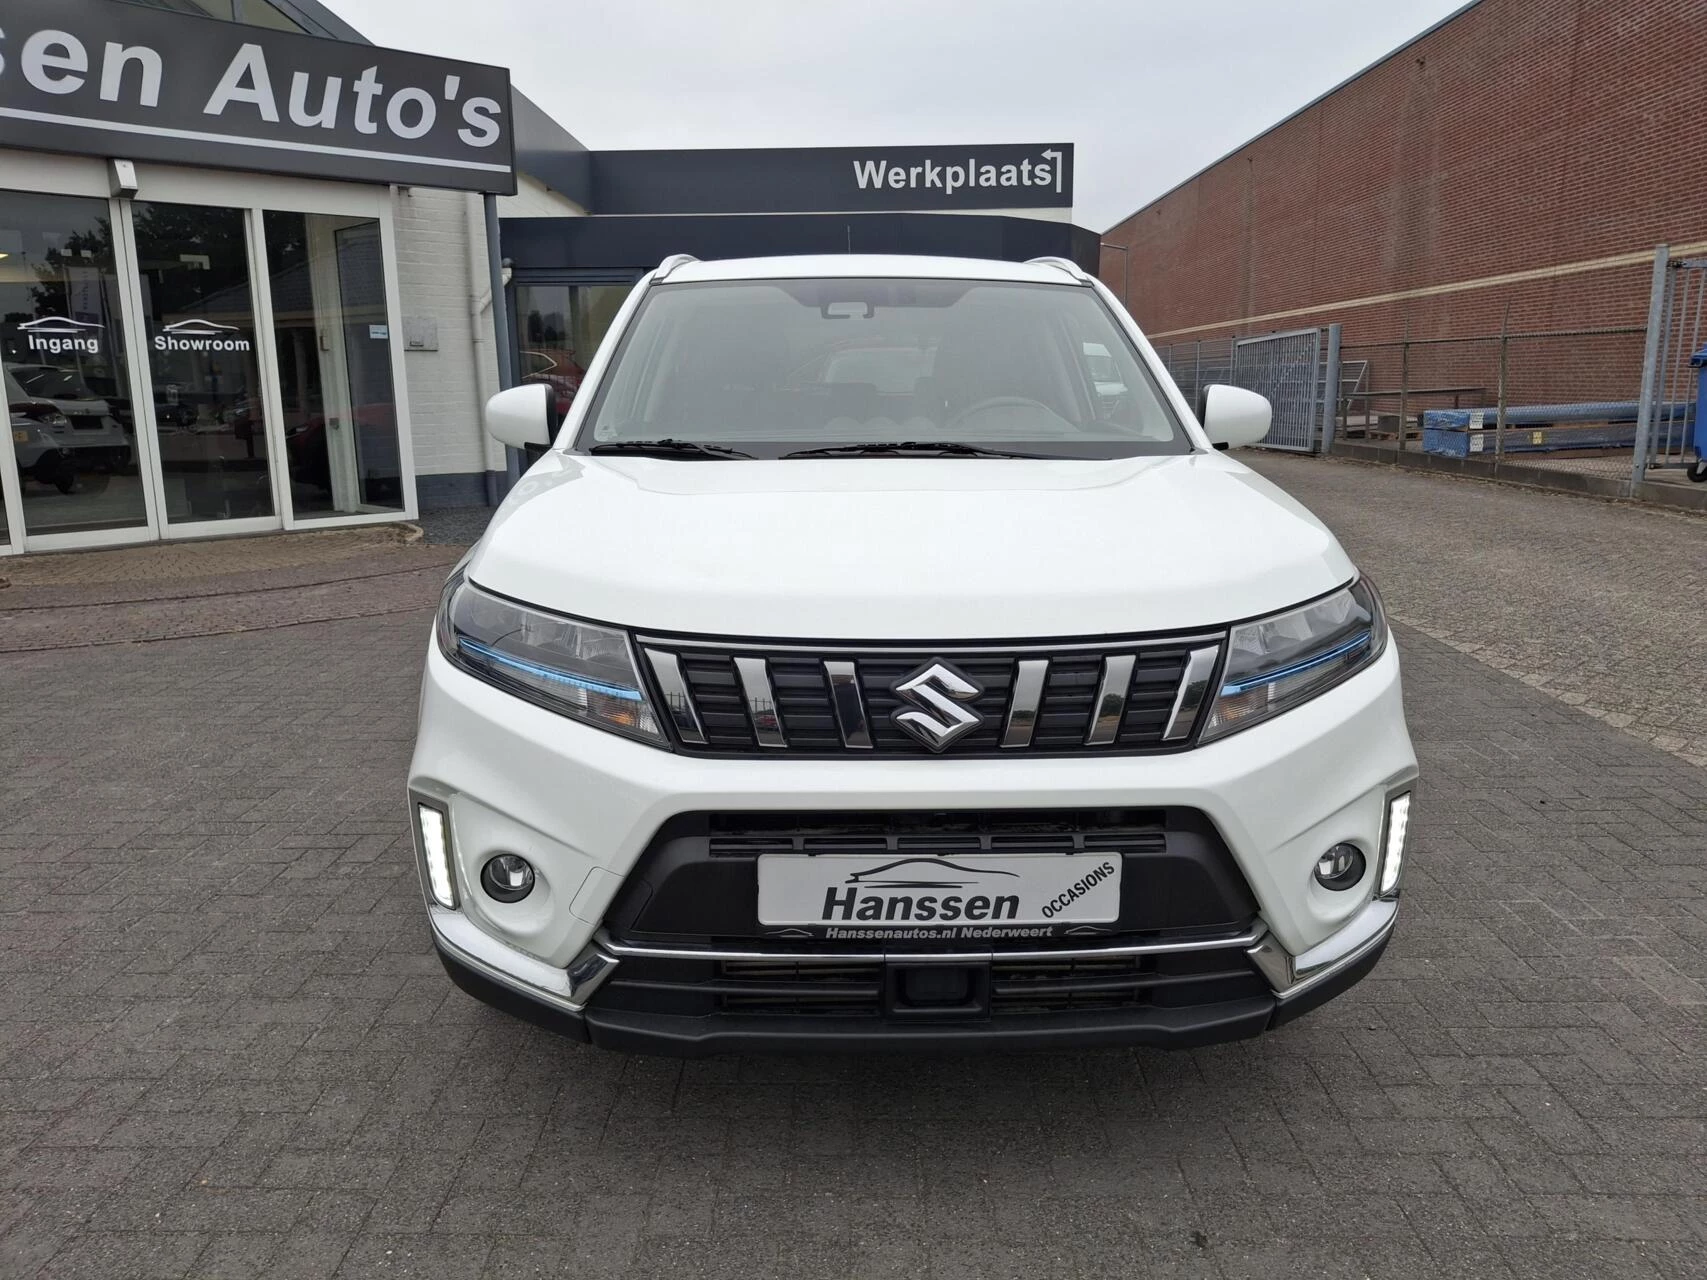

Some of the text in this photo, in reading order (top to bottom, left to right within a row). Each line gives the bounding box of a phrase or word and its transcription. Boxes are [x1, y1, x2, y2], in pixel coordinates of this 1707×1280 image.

[0, 27, 501, 148] en Auto's
[853, 158, 1052, 195] Werkplaats
[28, 334, 99, 354] Ingang
[154, 335, 251, 351] Showroom
[821, 886, 1020, 921] Hanssen
[1041, 860, 1115, 919] OCCASIONS
[825, 926, 1053, 940] Hanssenautos.nl Nederweert
